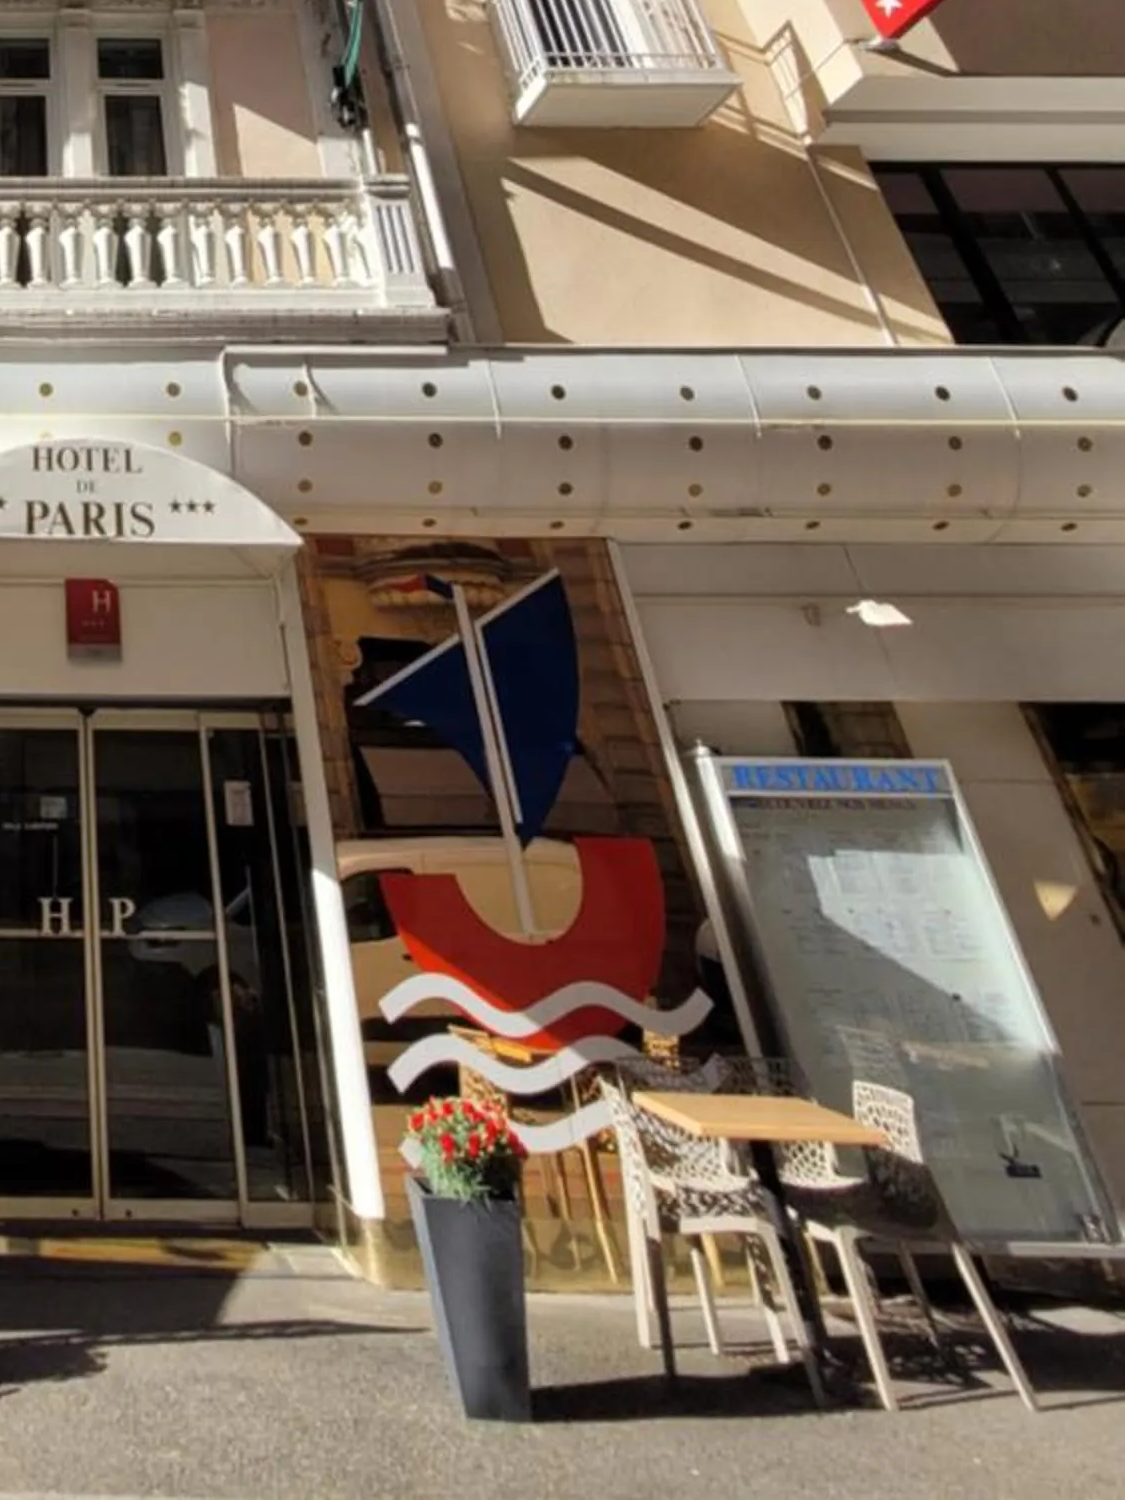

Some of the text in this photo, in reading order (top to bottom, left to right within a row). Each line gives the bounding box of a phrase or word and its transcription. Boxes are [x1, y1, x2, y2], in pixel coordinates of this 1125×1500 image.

[32, 445, 144, 474] HOTEL
[76, 480, 96, 494] DE
[25, 499, 156, 538] PARIS
[92, 589, 112, 613] H
[732, 763, 939, 794] RESTAURANT
[39, 897, 137, 936] H P
